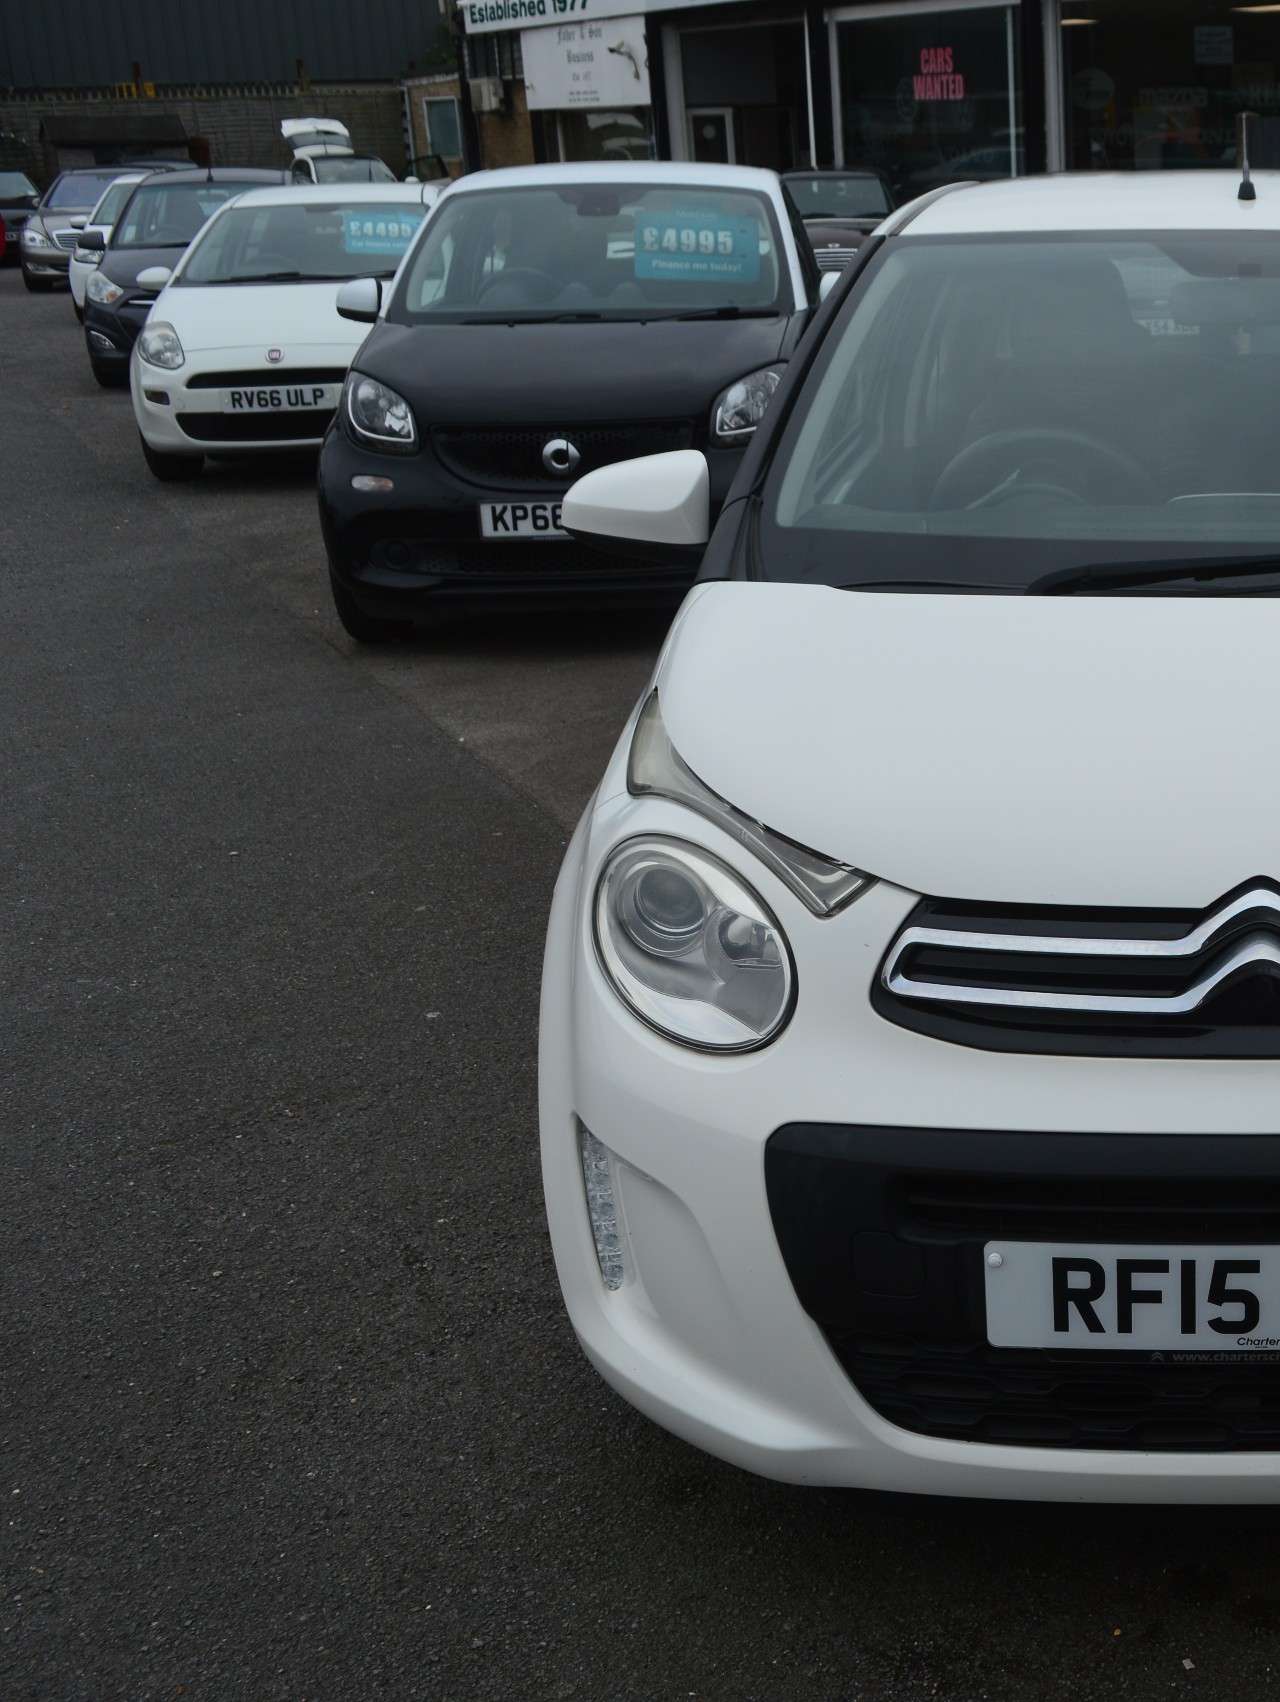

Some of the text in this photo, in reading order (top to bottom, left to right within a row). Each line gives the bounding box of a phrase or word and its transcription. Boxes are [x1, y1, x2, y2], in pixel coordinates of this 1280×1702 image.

[469, 0, 546, 23] Established
[920, 46, 954, 74] CARS
[912, 73, 966, 101] WANTED
[642, 226, 735, 255] £4995
[230, 387, 325, 410] RV66 ULP
[1051, 1256, 1261, 1335] RF15
